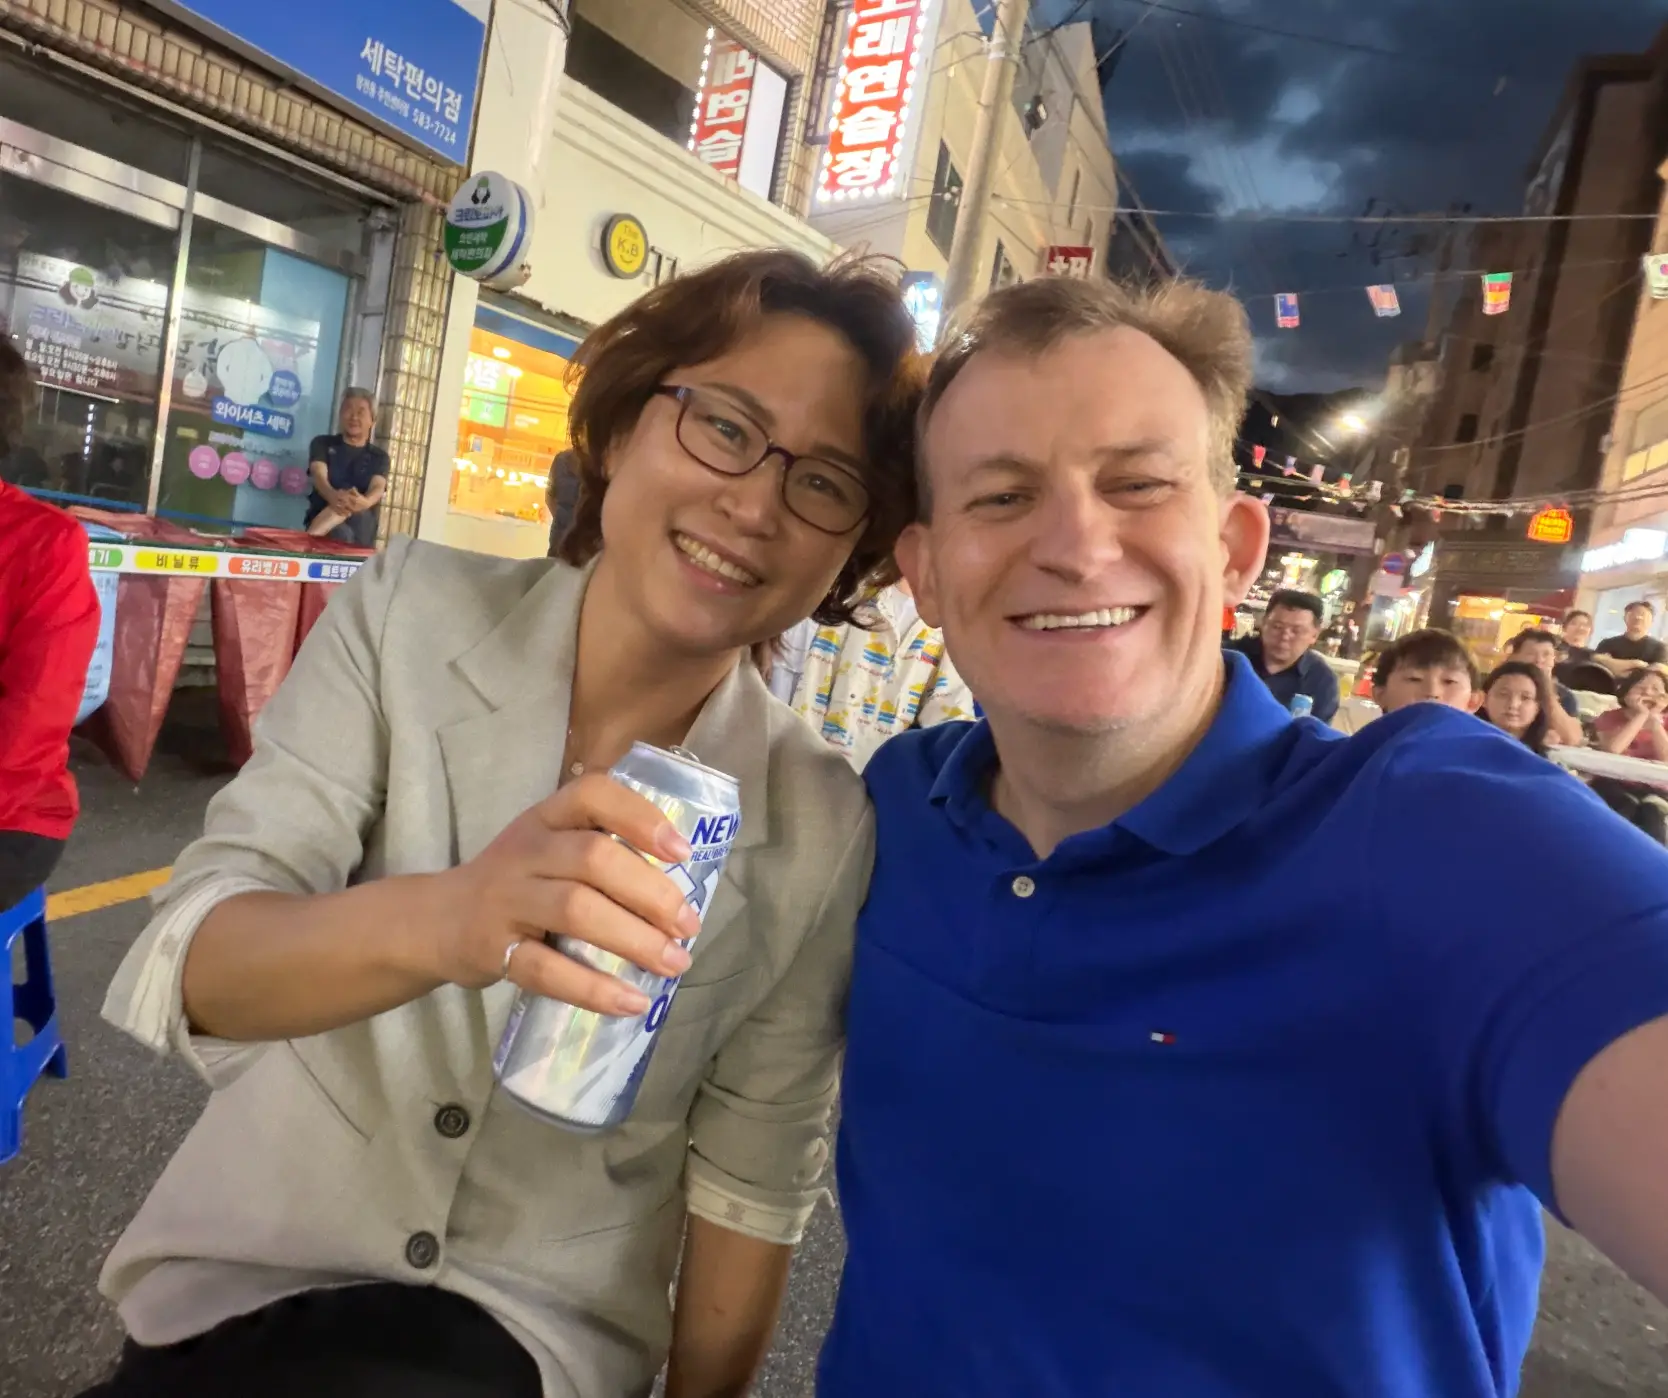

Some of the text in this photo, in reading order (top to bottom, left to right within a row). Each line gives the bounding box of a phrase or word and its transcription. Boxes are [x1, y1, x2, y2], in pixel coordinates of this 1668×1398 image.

[360, 37, 462, 124] 세탁편의점
[215, 401, 292, 435] 와이셔츠 세탁
